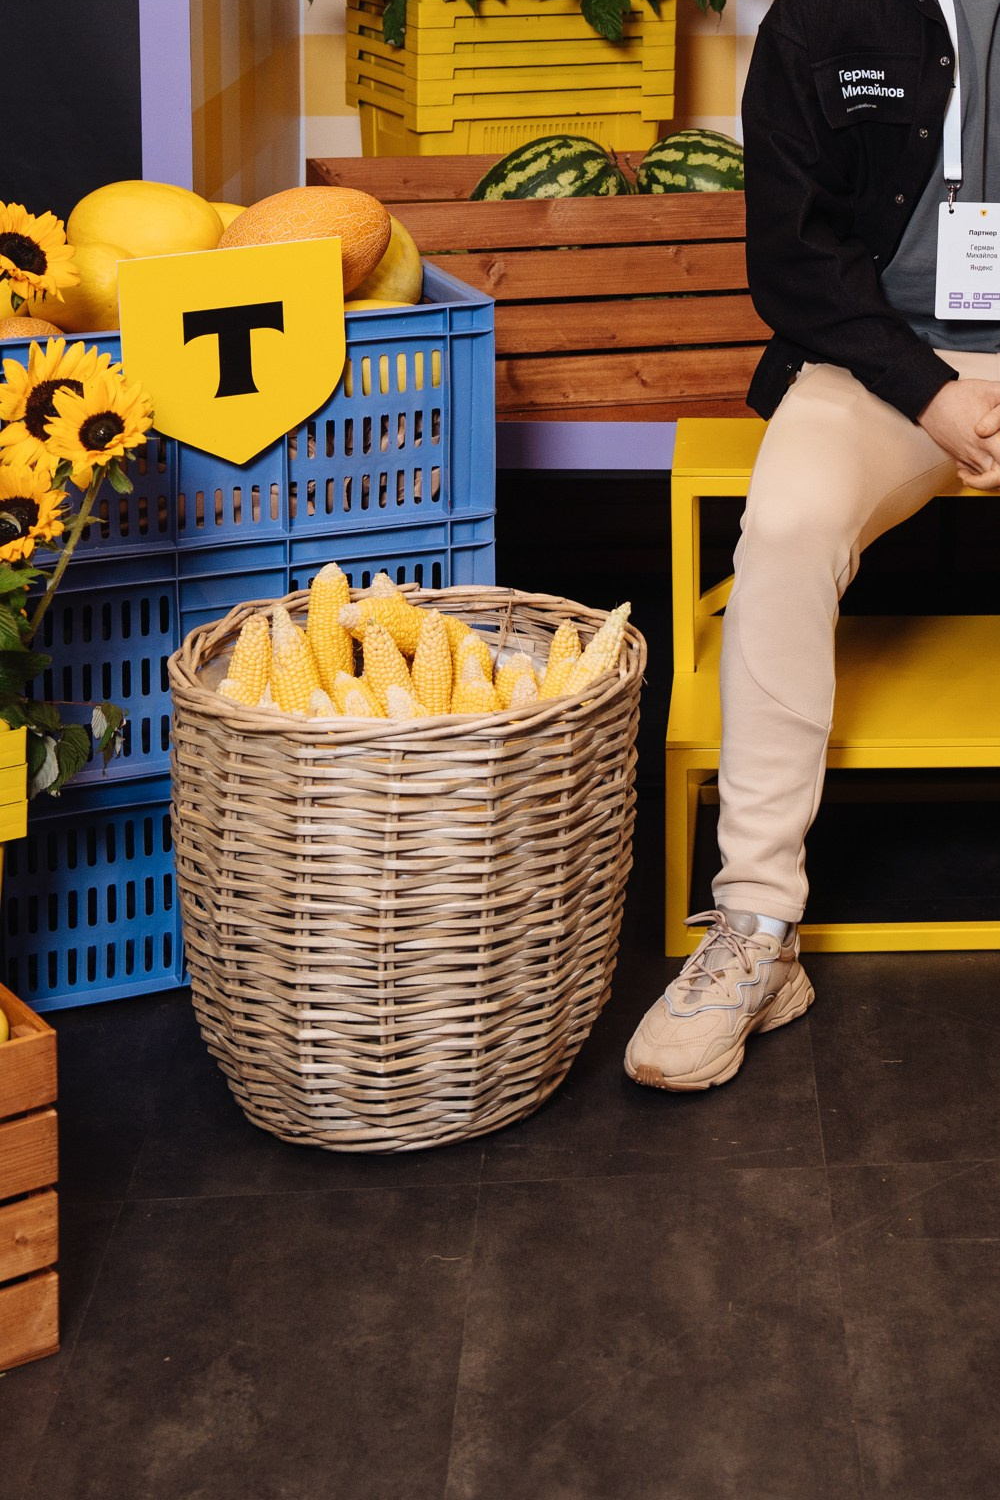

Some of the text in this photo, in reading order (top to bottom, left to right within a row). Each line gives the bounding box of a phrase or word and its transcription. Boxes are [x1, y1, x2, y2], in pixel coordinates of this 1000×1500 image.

[838, 69, 885, 83] Герман
[841, 83, 905, 99] Михайлов
[968, 229, 998, 237] Партнер
